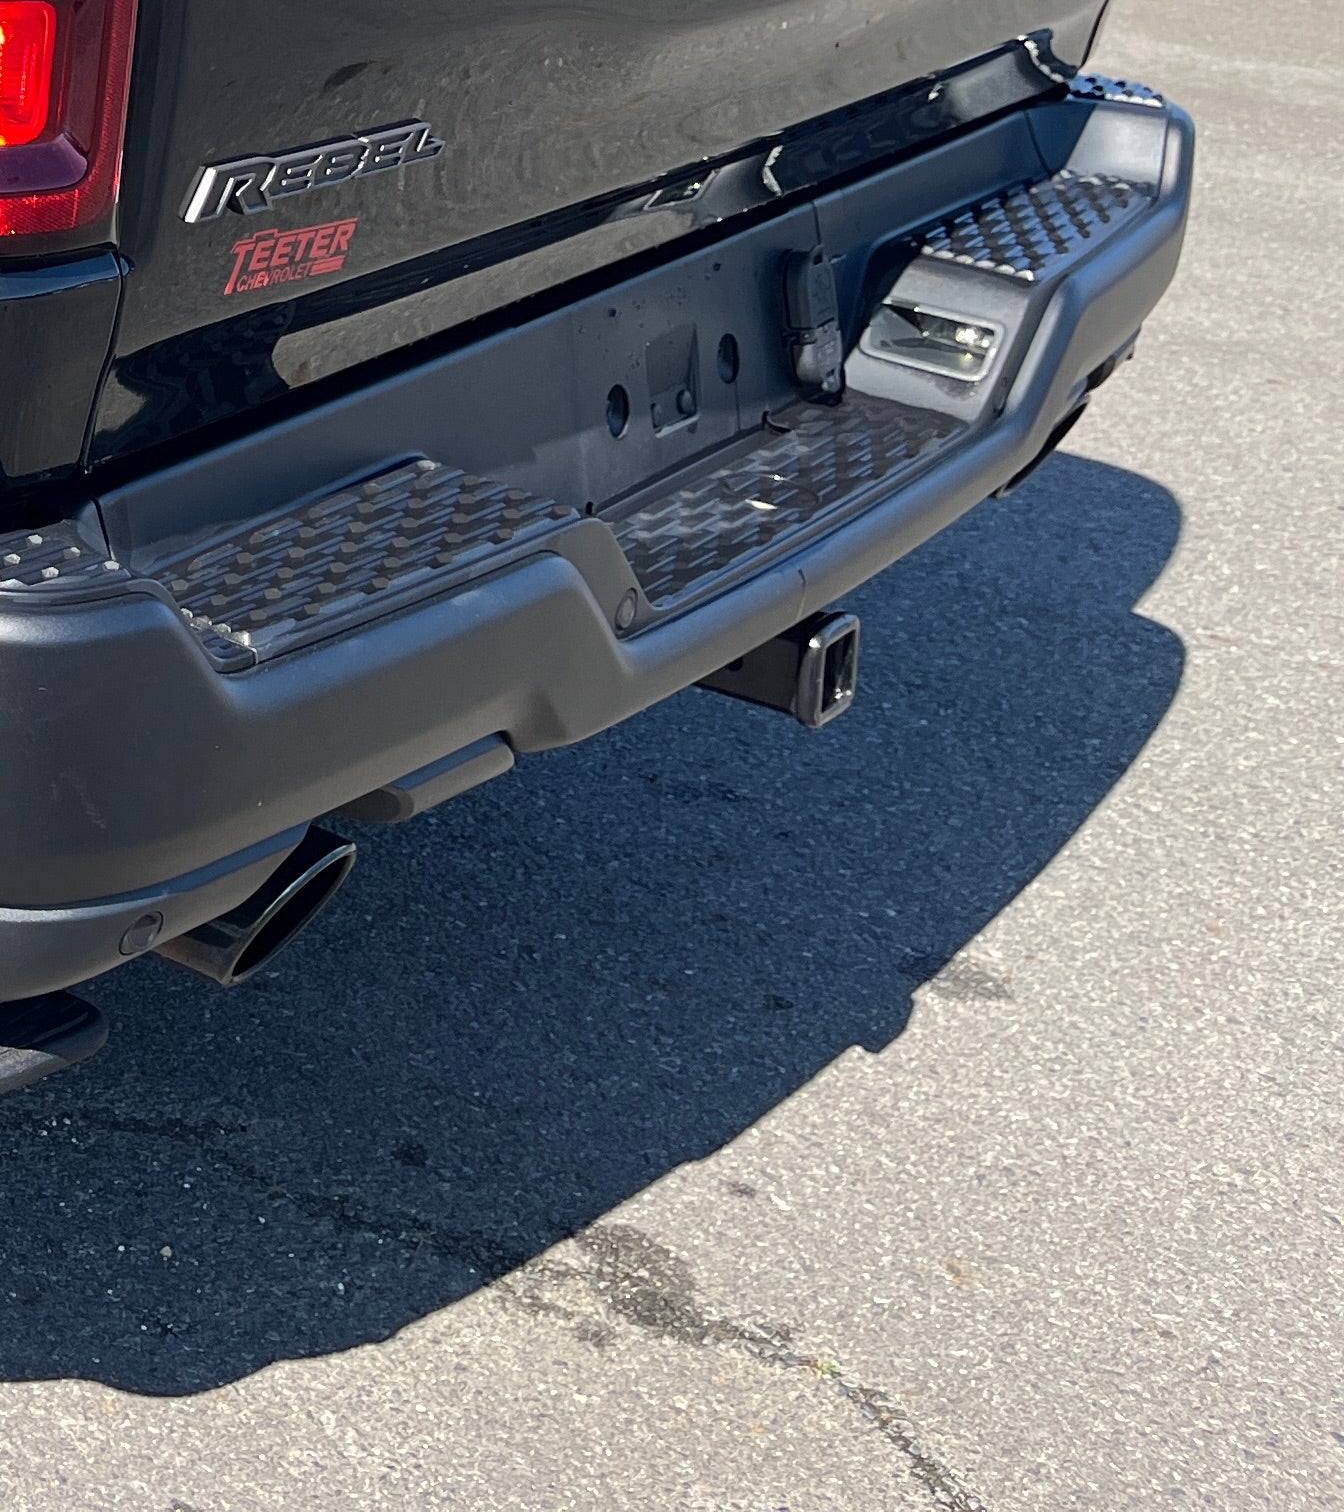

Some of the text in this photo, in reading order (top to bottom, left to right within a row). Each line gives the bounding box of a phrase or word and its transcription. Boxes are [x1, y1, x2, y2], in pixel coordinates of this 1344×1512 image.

[179, 118, 445, 223] REBEL
[223, 221, 357, 296] TEETER
[236, 263, 312, 293] CHEVROLET
